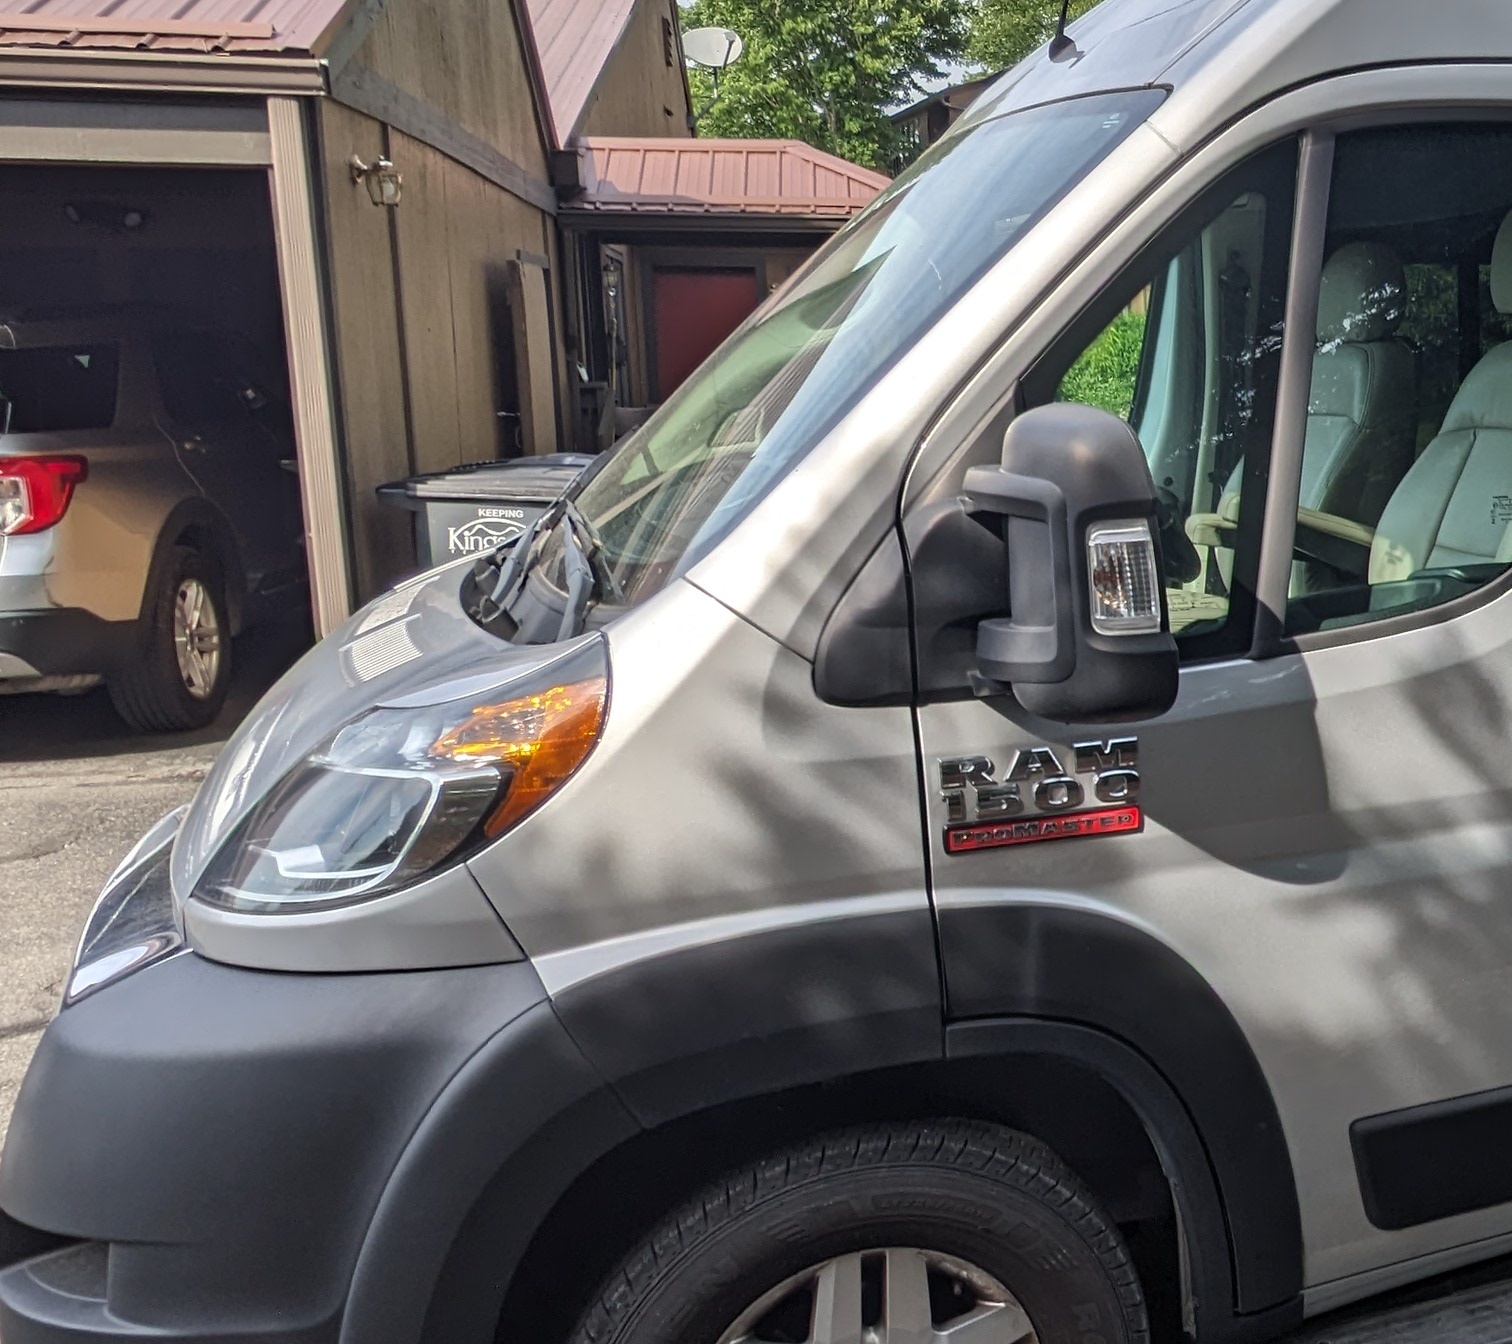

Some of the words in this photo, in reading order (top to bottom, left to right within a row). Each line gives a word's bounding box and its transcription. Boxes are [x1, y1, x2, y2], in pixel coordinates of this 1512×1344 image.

[478, 508, 524, 519] KEEPING
[937, 736, 1138, 789] RAM
[940, 768, 1141, 822] 1500
